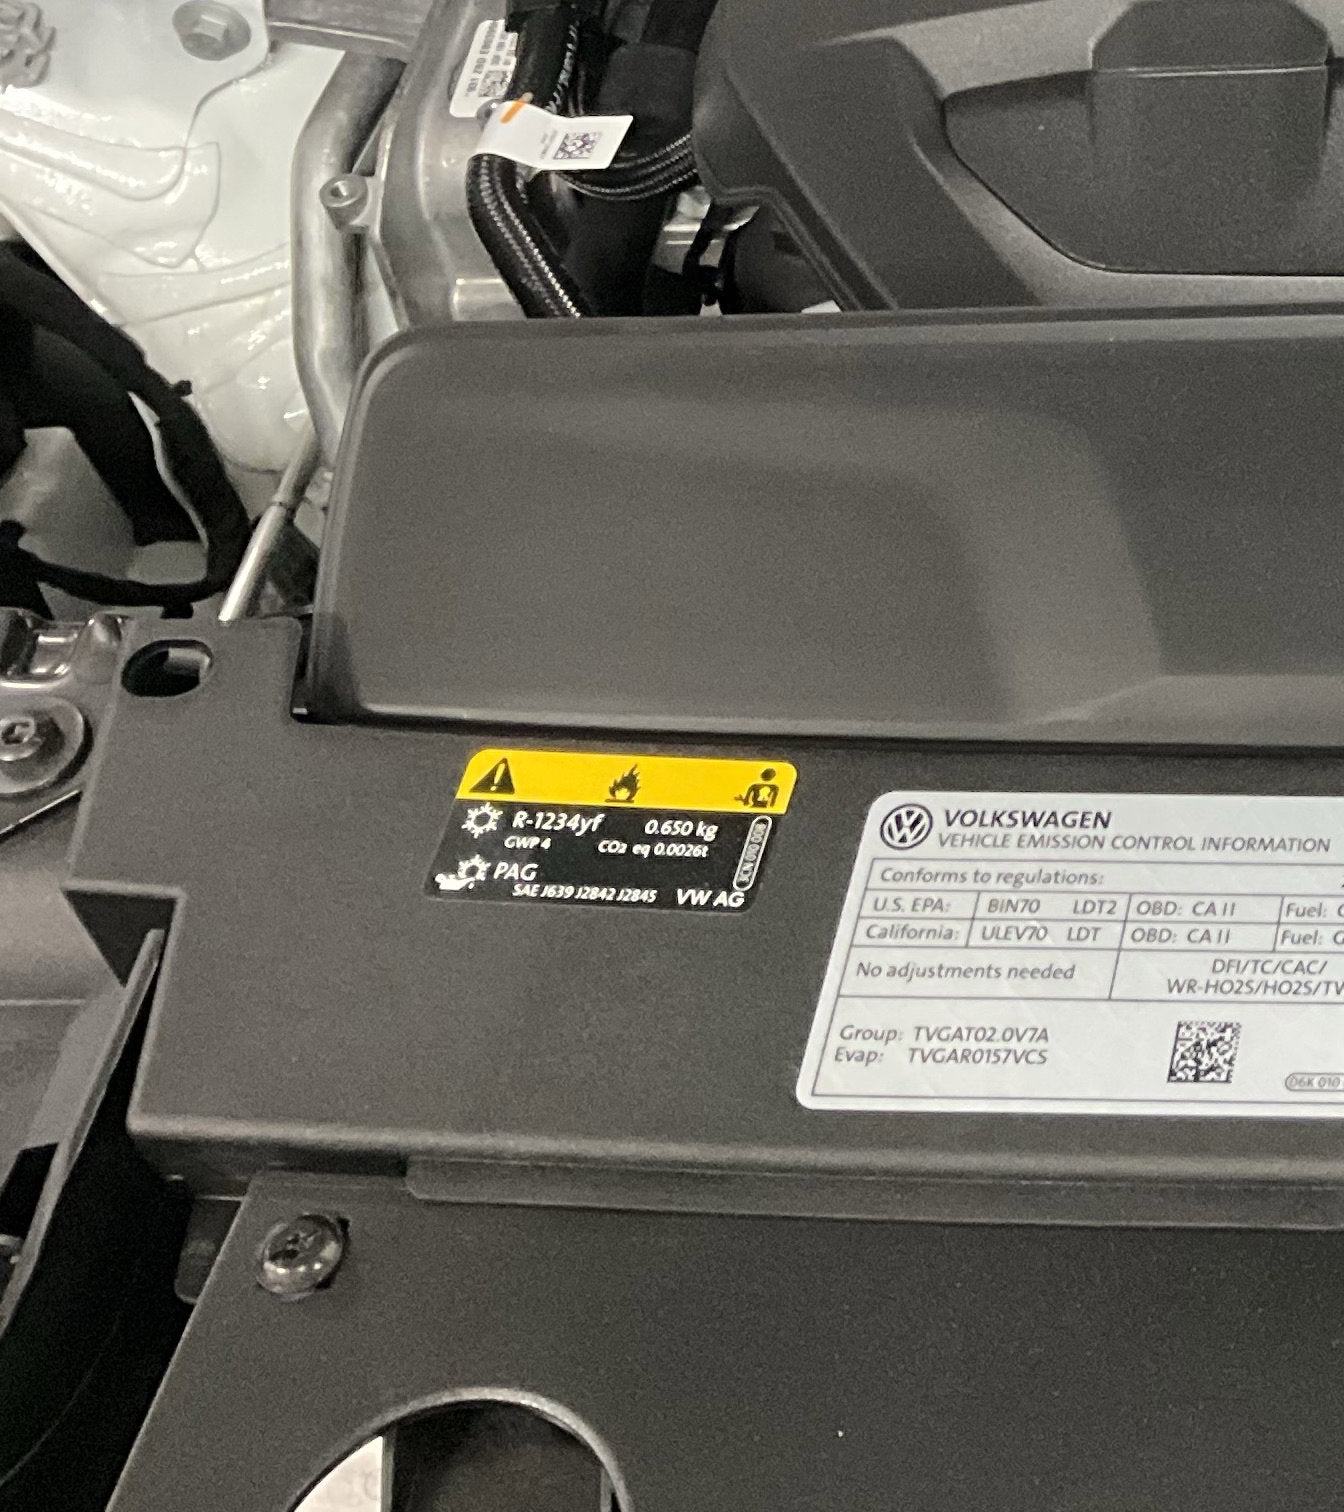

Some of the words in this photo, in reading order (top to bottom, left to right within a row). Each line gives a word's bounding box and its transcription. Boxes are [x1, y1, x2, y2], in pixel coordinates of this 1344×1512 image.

[511, 810, 606, 837] R-1234yf
[944, 809, 1112, 829] VOLKSWAGEN
[644, 819, 694, 837] 0.650
[695, 820, 719, 842] kg
[503, 835, 541, 849] GWP
[540, 837, 552, 850] 4
[631, 843, 652, 859] eq
[653, 841, 709, 858] 0.0026t
[938, 832, 1011, 849] VEHICLE
[1016, 833, 1106, 850] EMISSION
[1110, 835, 1196, 851] CONTROL
[1201, 836, 1331, 853] INFORMATION
[493, 860, 539, 881] PAG
[880, 867, 968, 884] Conforms
[973, 868, 992, 884] to
[995, 867, 1104, 888] regulations:
[511, 881, 541, 898] SAE
[539, 884, 575, 899] J639
[574, 885, 617, 901] J2842
[615, 887, 658, 903] J2845
[676, 888, 713, 906] VW
[712, 889, 747, 908] AG
[873, 897, 905, 913] U.S.
[910, 897, 951, 913] EPA:
[987, 898, 1041, 914] BIN70
[1072, 899, 1118, 915] LDT2
[1136, 900, 1183, 916] OBD:
[1191, 900, 1217, 917] CA
[1222, 902, 1236, 917] II
[1285, 902, 1326, 918] Fuel:
[865, 923, 959, 941] California:
[981, 925, 1049, 942] ULEV70
[1066, 926, 1102, 942] LDT
[1130, 927, 1177, 944] OBD:
[1186, 928, 1212, 944] CA
[1216, 928, 1231, 944] II
[1280, 929, 1322, 945] Fuel:
[856, 961, 883, 978] No
[886, 961, 1002, 981] adjustments
[1007, 963, 1076, 980] needed
[839, 1024, 902, 1046] Group:
[834, 1046, 884, 1067] Evap:
[1318, 1076, 1340, 1088] 010
